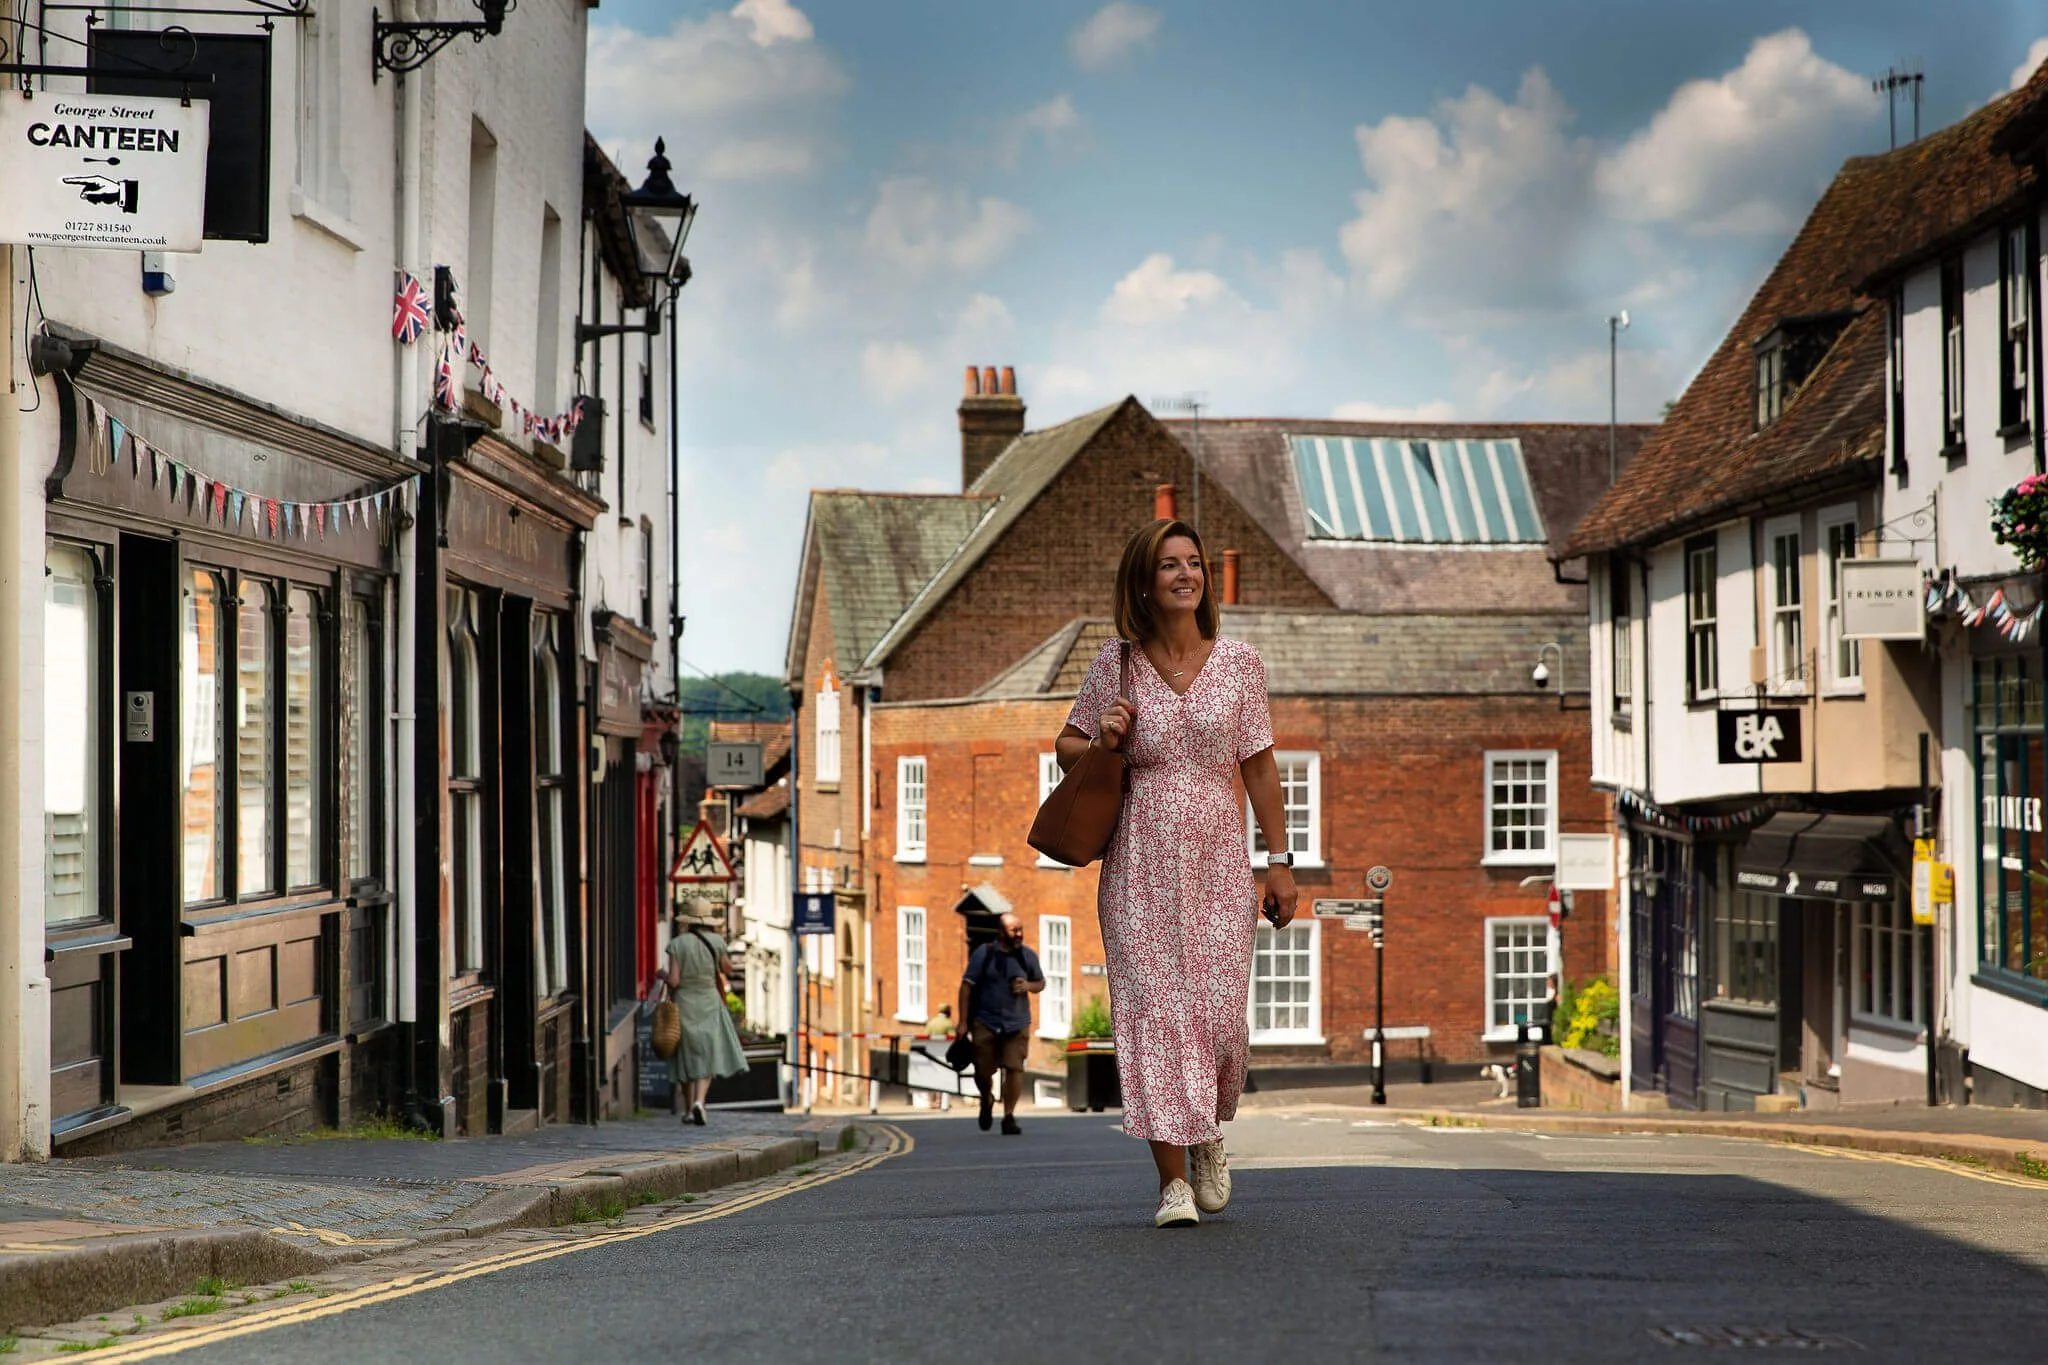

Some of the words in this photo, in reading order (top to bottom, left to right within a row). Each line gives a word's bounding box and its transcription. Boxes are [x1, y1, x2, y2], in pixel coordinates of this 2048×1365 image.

[54, 103, 106, 119] George
[110, 105, 154, 120] Street
[27, 122, 180, 153] CANTEEN
[65, 221, 94, 232] 01727
[96, 223, 132, 234] 831540
[27, 231, 167, 246] www.georgestreetcanteen.co.uk
[726, 751, 744, 767] 14
[681, 887, 725, 900] School
